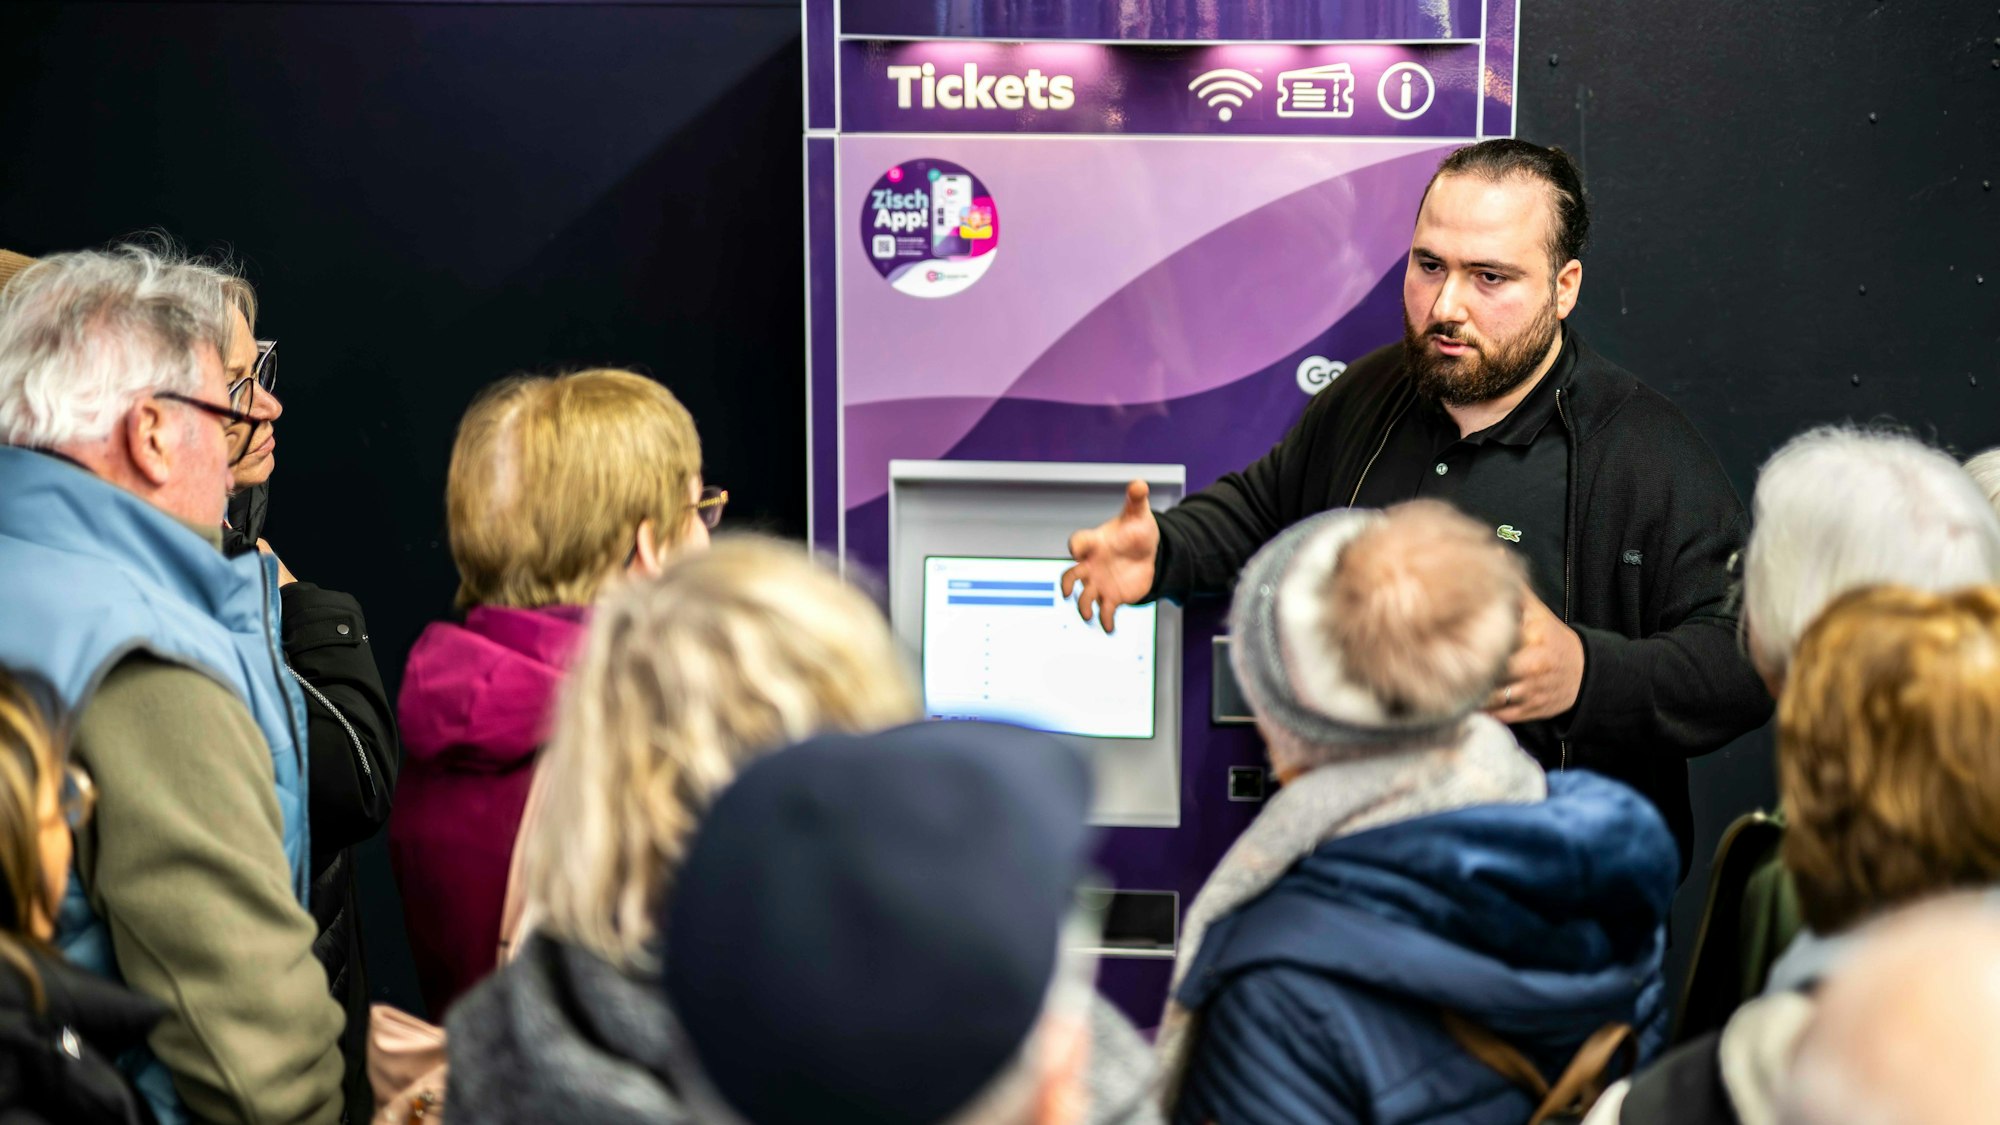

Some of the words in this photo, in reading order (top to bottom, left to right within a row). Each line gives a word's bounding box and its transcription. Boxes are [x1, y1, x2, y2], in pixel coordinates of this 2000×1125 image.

[887, 62, 1075, 110] Tickets
[872, 189, 929, 209] Zisch
[874, 208, 929, 232] App!
